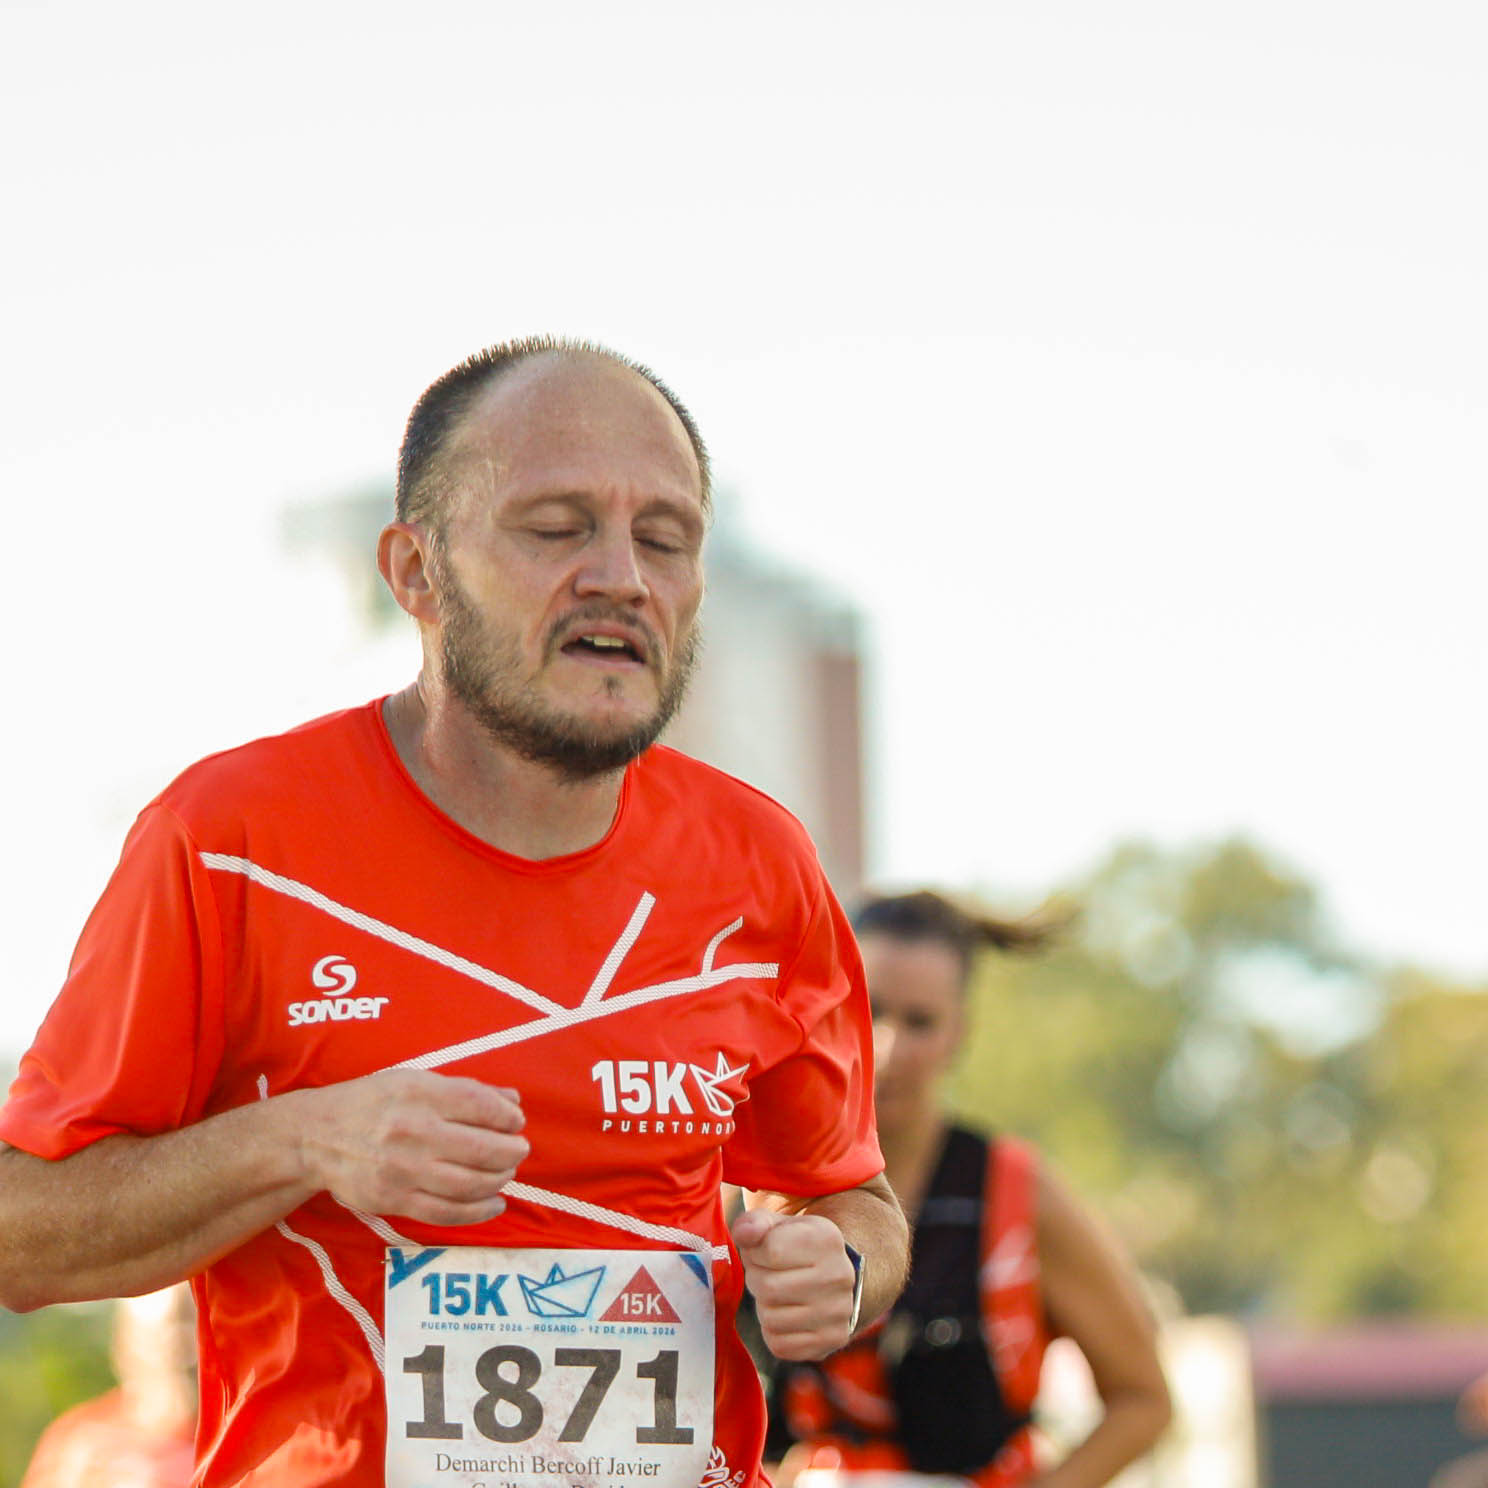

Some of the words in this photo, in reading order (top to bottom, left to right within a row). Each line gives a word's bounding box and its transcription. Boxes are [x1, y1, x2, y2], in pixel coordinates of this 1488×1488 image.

[592, 1060, 694, 1114] 15K
[421, 1272, 509, 1316] 15K
[620, 1293, 663, 1316] 15K
[421, 1321, 460, 1331] PUERTO
[463, 1322, 496, 1332] NORTE
[534, 1323, 577, 1333] ROSARIO
[603, 1326, 616, 1334] DE
[619, 1326, 649, 1335] ABRIL
[403, 1344, 694, 1445] 1871
[436, 1453, 524, 1473] Demarchi
[532, 1455, 604, 1475] Bercoff
[607, 1457, 661, 1476] Javier
